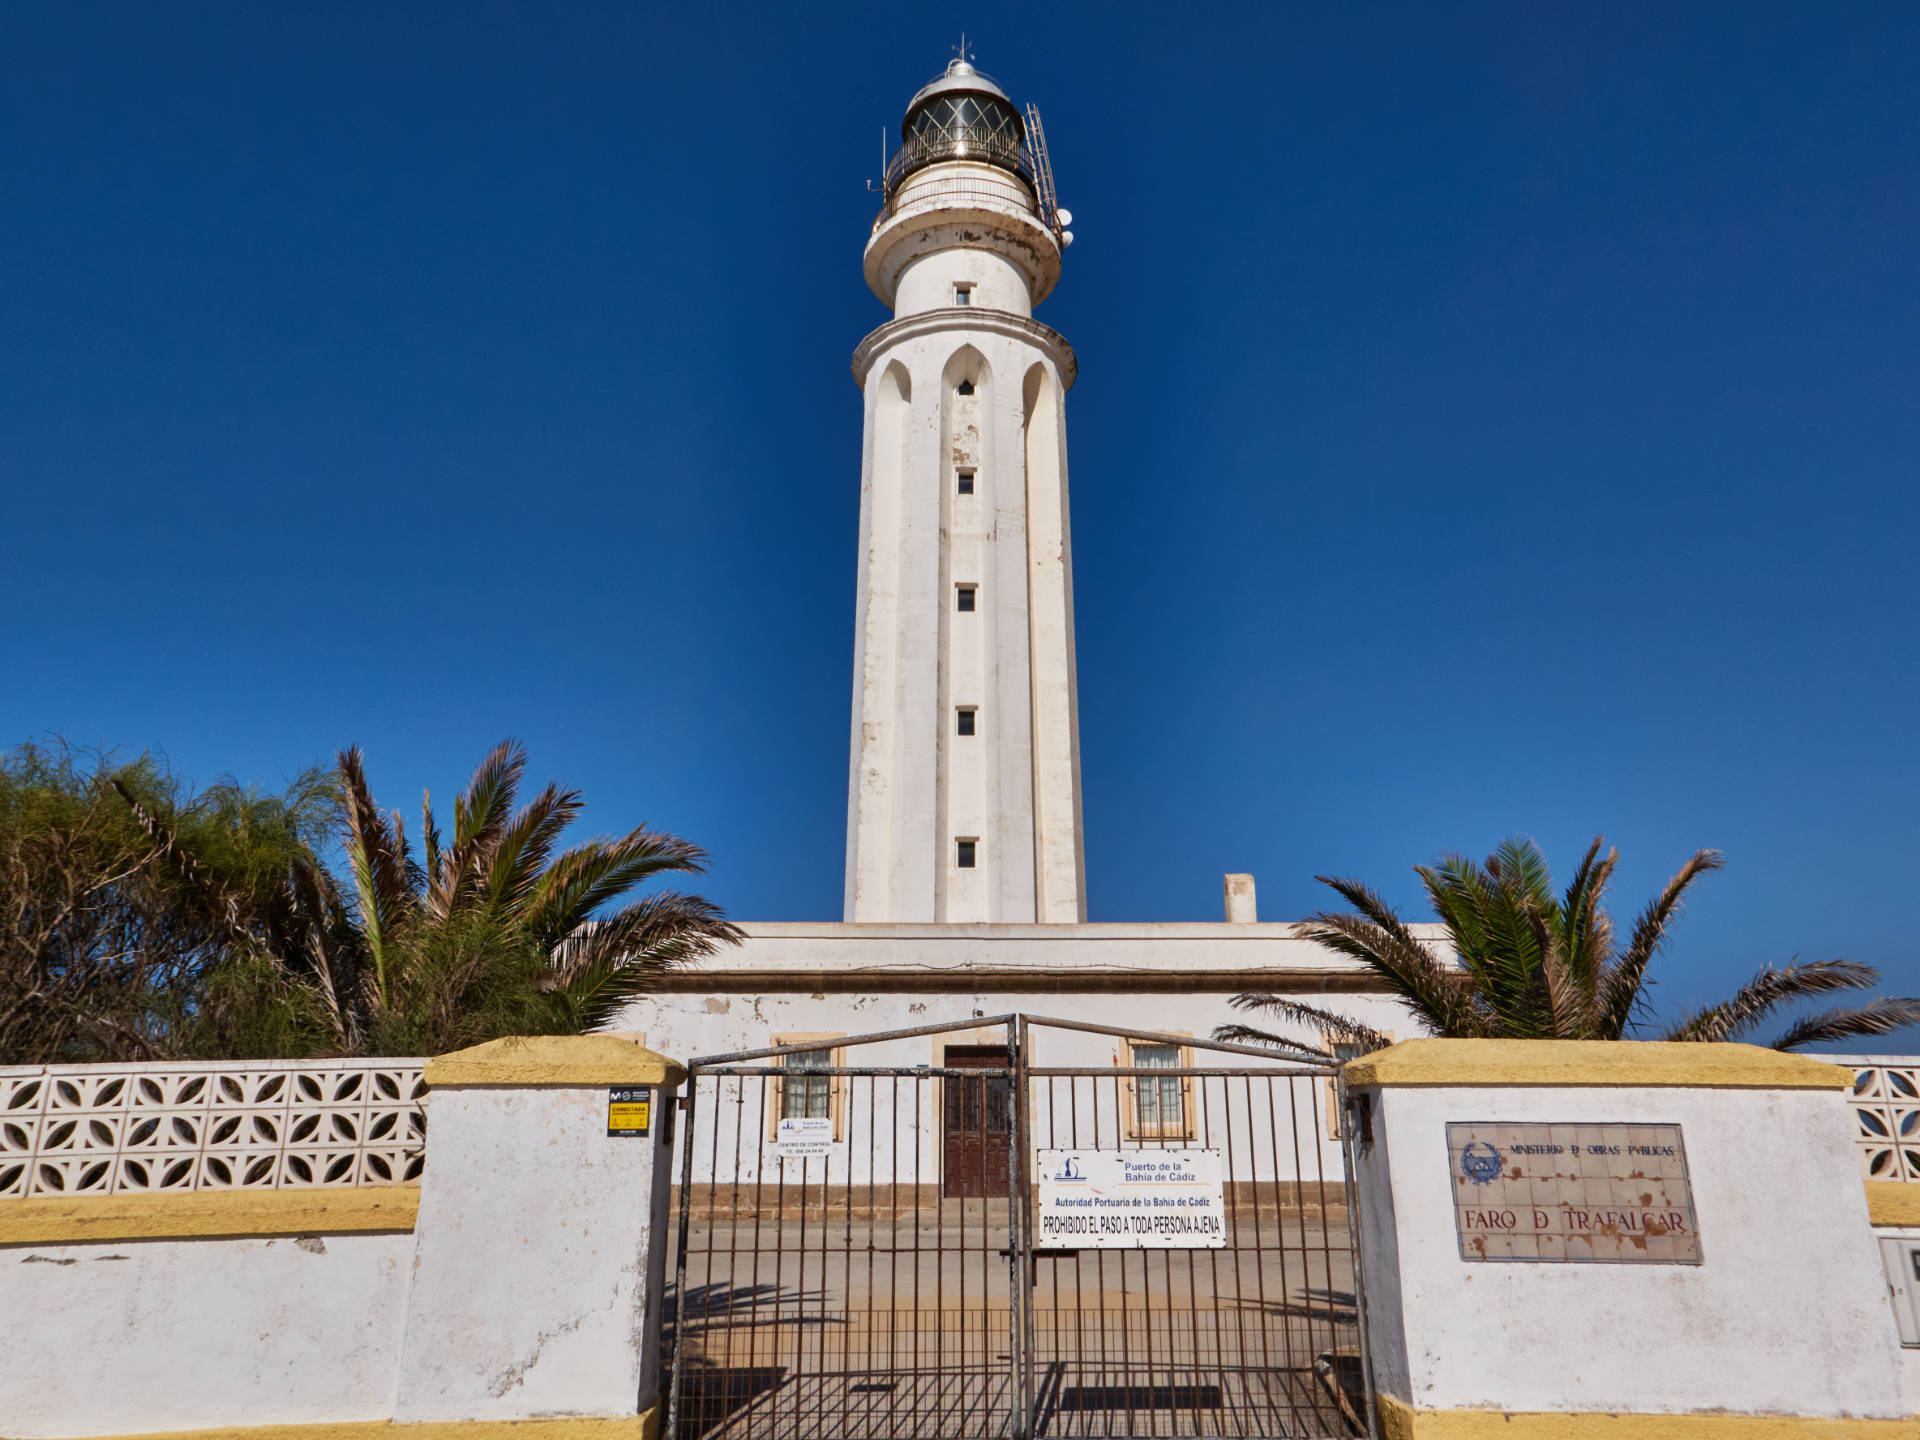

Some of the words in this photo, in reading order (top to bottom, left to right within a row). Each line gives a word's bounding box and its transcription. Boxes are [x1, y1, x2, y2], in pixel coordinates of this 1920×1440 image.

[1510, 1144, 1564, 1155] MINISTERIO
[1587, 1145, 1620, 1155] OBRAS
[1125, 1162, 1156, 1171] Puerto
[1158, 1162, 1170, 1171] de
[1173, 1162, 1182, 1171] la
[1155, 1173, 1166, 1182] de
[1169, 1172, 1196, 1182] Cádiz
[1055, 1197, 1092, 1207] Autoridad
[1094, 1197, 1130, 1207] Portuaria
[1132, 1197, 1142, 1207] de
[1143, 1197, 1151, 1207] la
[1177, 1197, 1187, 1207] de
[1044, 1215, 1087, 1234] PROHIBIDO
[1089, 1215, 1099, 1234] EL
[1101, 1215, 1122, 1234] PASO
[1124, 1215, 1130, 1234] A
[1130, 1215, 1153, 1234] TODA
[1154, 1215, 1193, 1234] PERSONA
[1194, 1215, 1220, 1234] AJENA
[1465, 1210, 1516, 1230] FARO
